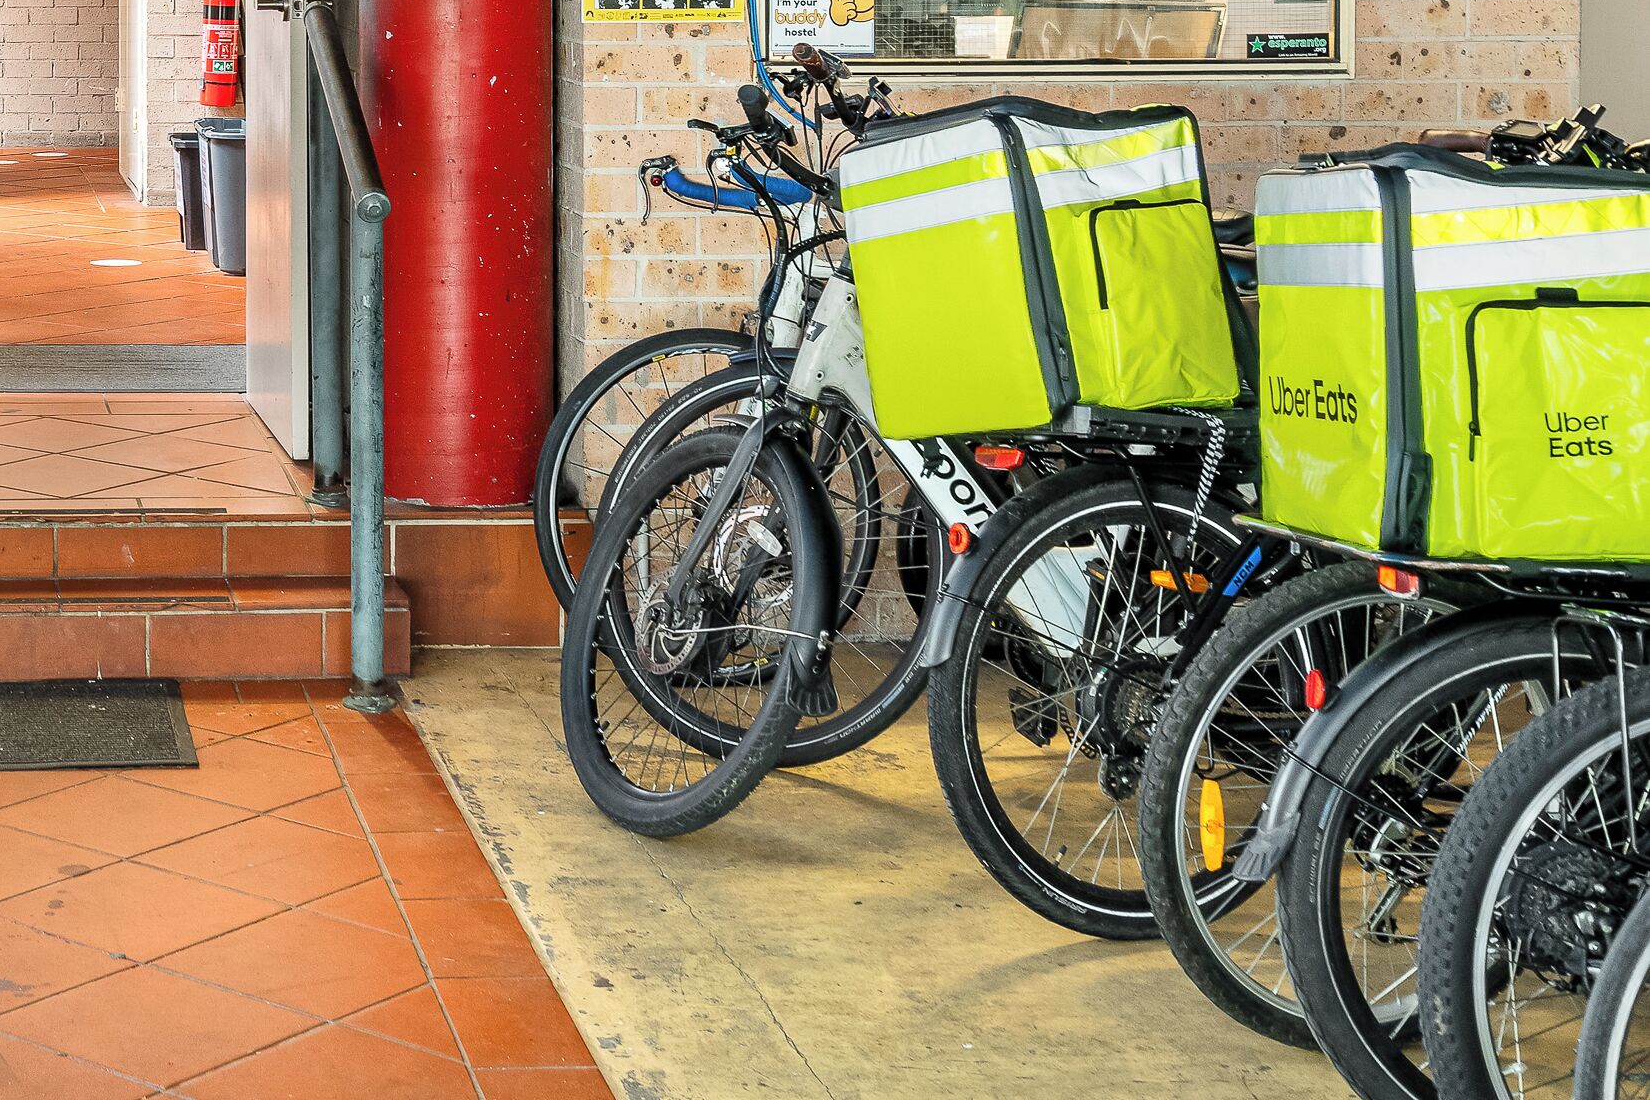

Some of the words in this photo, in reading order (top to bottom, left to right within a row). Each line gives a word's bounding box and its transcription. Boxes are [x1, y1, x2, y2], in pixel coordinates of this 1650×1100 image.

[793, 0, 818, 9] your
[775, 9, 827, 28] buddy
[785, 27, 817, 37] hostel
[1267, 38, 1327, 50] esperanto
[1269, 375, 1310, 418] Uber
[1314, 380, 1357, 426] Eats
[1545, 412, 1609, 433] Uber
[1549, 437, 1613, 458] Eats
